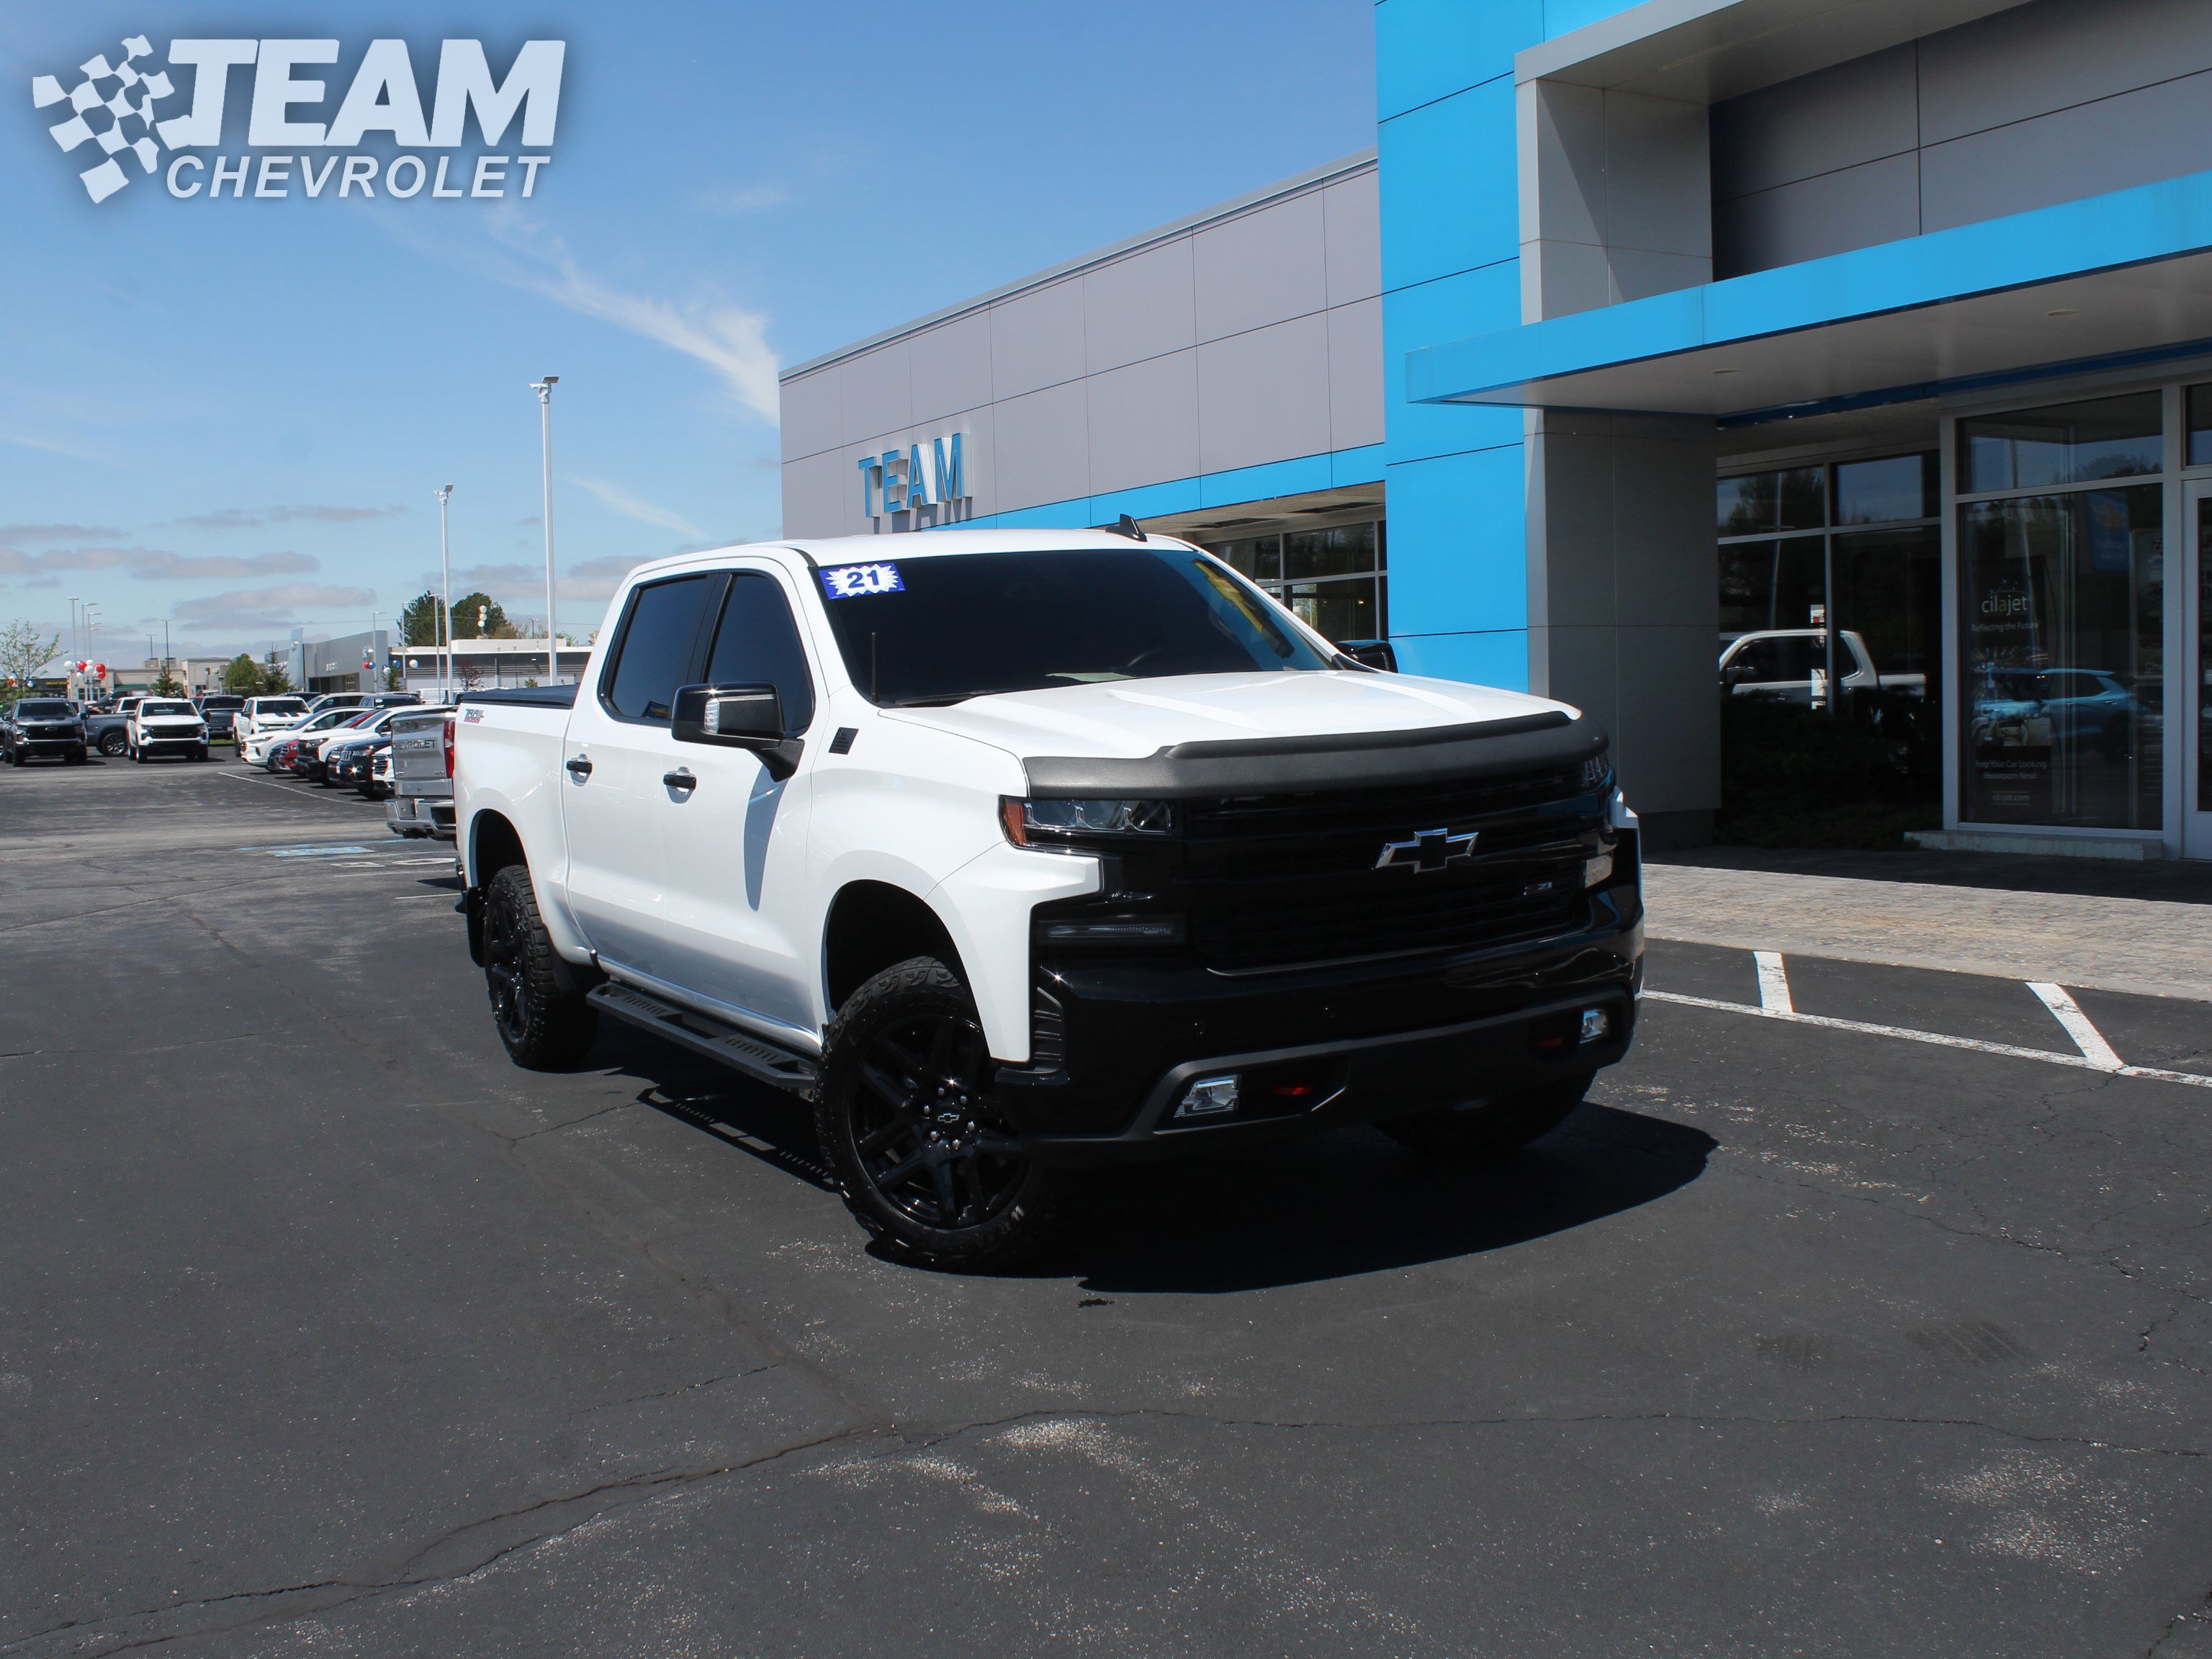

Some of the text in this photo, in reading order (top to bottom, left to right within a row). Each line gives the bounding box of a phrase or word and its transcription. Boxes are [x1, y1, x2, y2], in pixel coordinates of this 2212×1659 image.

[858, 433, 971, 518] TEAM
[846, 570, 879, 589] 21
[1982, 594, 2028, 616] cilajet
[1971, 623, 2004, 632] Reflecting
[465, 709, 485, 718] TRAIL
[2018, 760, 2046, 770] Looking
